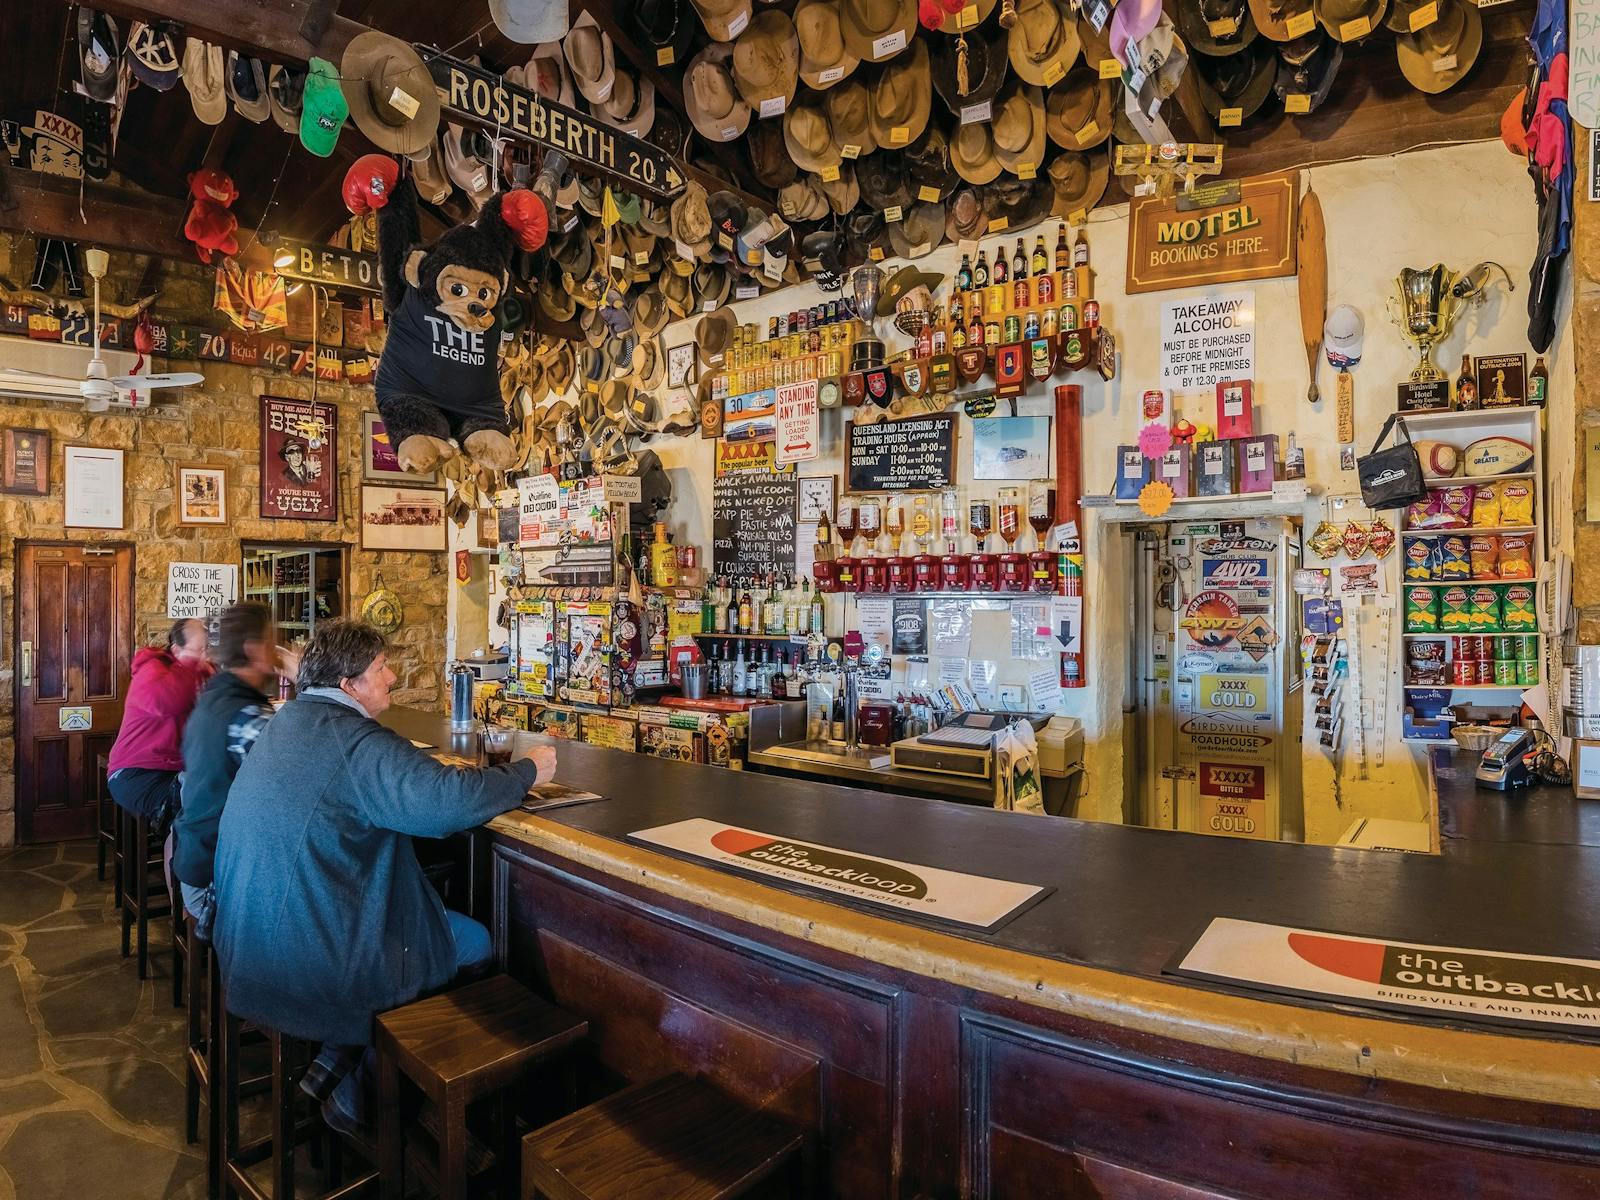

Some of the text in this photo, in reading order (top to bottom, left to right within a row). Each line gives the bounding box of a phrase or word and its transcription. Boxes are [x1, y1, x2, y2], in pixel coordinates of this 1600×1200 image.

[41, 113, 81, 145] XXXX
[450, 68, 656, 184] ROSEBERTH 20
[1157, 205, 1259, 243] MOTEL
[1150, 242, 1218, 267] BOOKINGS
[8, 306, 22, 324] 51
[1172, 299, 1244, 320] TAKEAWAY
[61, 317, 90, 347] 22
[1173, 317, 1242, 335] ALCOHOL
[423, 314, 485, 353] THE
[200, 333, 226, 358] 70
[1163, 333, 1251, 352] MUST BE PURCHASED
[263, 342, 287, 367] 42
[291, 349, 315, 373] 75
[432, 343, 486, 366] LEGEND
[1170, 346, 1244, 364] BEFORE MIDNIGHT
[1164, 359, 1251, 376] & OFF THE PREMISES
[1182, 376, 1193, 387] BY
[1408, 382, 1439, 392] Birdsville
[779, 384, 815, 405] STANDING
[1414, 391, 1433, 399] Hotel
[270, 403, 285, 411] BUY
[284, 404, 296, 412] ME
[730, 397, 743, 415] 30
[779, 400, 816, 421] ANY TIME
[784, 418, 811, 429] GETTING
[853, 419, 950, 436] QUEENSLAND LICENSING ACT
[785, 426, 810, 436] LOADED
[789, 433, 806, 442] ZONE
[853, 430, 940, 446] TRADING HOURS (APPROX)
[720, 442, 769, 460] XXXX
[851, 446, 867, 456] MON
[875, 445, 889, 455] SAT
[720, 458, 769, 469] The popular beer
[851, 455, 880, 466] SUNDAY
[1473, 455, 1500, 465] GREATER
[713, 485, 793, 497] WHEN THE COOK
[881, 481, 910, 489] PATRONAGE
[1505, 488, 1528, 496] SMITHS
[302, 489, 322, 498] STILL
[276, 495, 323, 513] UGLY
[714, 496, 797, 508] HAS NICKED OFF
[740, 508, 754, 520] PIE
[740, 520, 768, 530] PASTIE
[767, 531, 781, 541] ROLL
[714, 538, 734, 549] PIZZA
[1212, 539, 1275, 551] BULTON
[737, 551, 771, 561] SUPREME
[172, 565, 222, 580] CROSS THE
[725, 561, 756, 574] COURSE
[759, 560, 784, 573] MEAL
[1211, 560, 1261, 577] 4WD
[173, 581, 224, 594] WHITE LINE
[173, 595, 196, 604] AND
[1412, 592, 1434, 600] SMITHS
[1445, 593, 1469, 601] SMITHS
[1507, 591, 1532, 599] SMITHS
[171, 605, 219, 617] SHOUT THE
[1188, 593, 1239, 618] TERRAIN TAMER
[1180, 618, 1247, 630] 4WD
[1220, 680, 1247, 690] XXXX
[1210, 692, 1257, 708] GOLD
[1190, 722, 1260, 734] BIRDSVILLE
[1191, 735, 1259, 748] ROADHOUSE
[1213, 769, 1251, 784] XXXX
[1219, 785, 1244, 794] BITTER
[1218, 804, 1246, 814] XXXX
[1209, 816, 1256, 833] GOLD
[769, 842, 809, 858] the
[749, 849, 916, 895] outbackloop
[720, 855, 913, 907] BIRDSVILLE AND INNAMINCKA HOTELS
[1397, 953, 1464, 972] the
[1377, 989, 1600, 1021] BIRDSVILLE AND INNAMI
